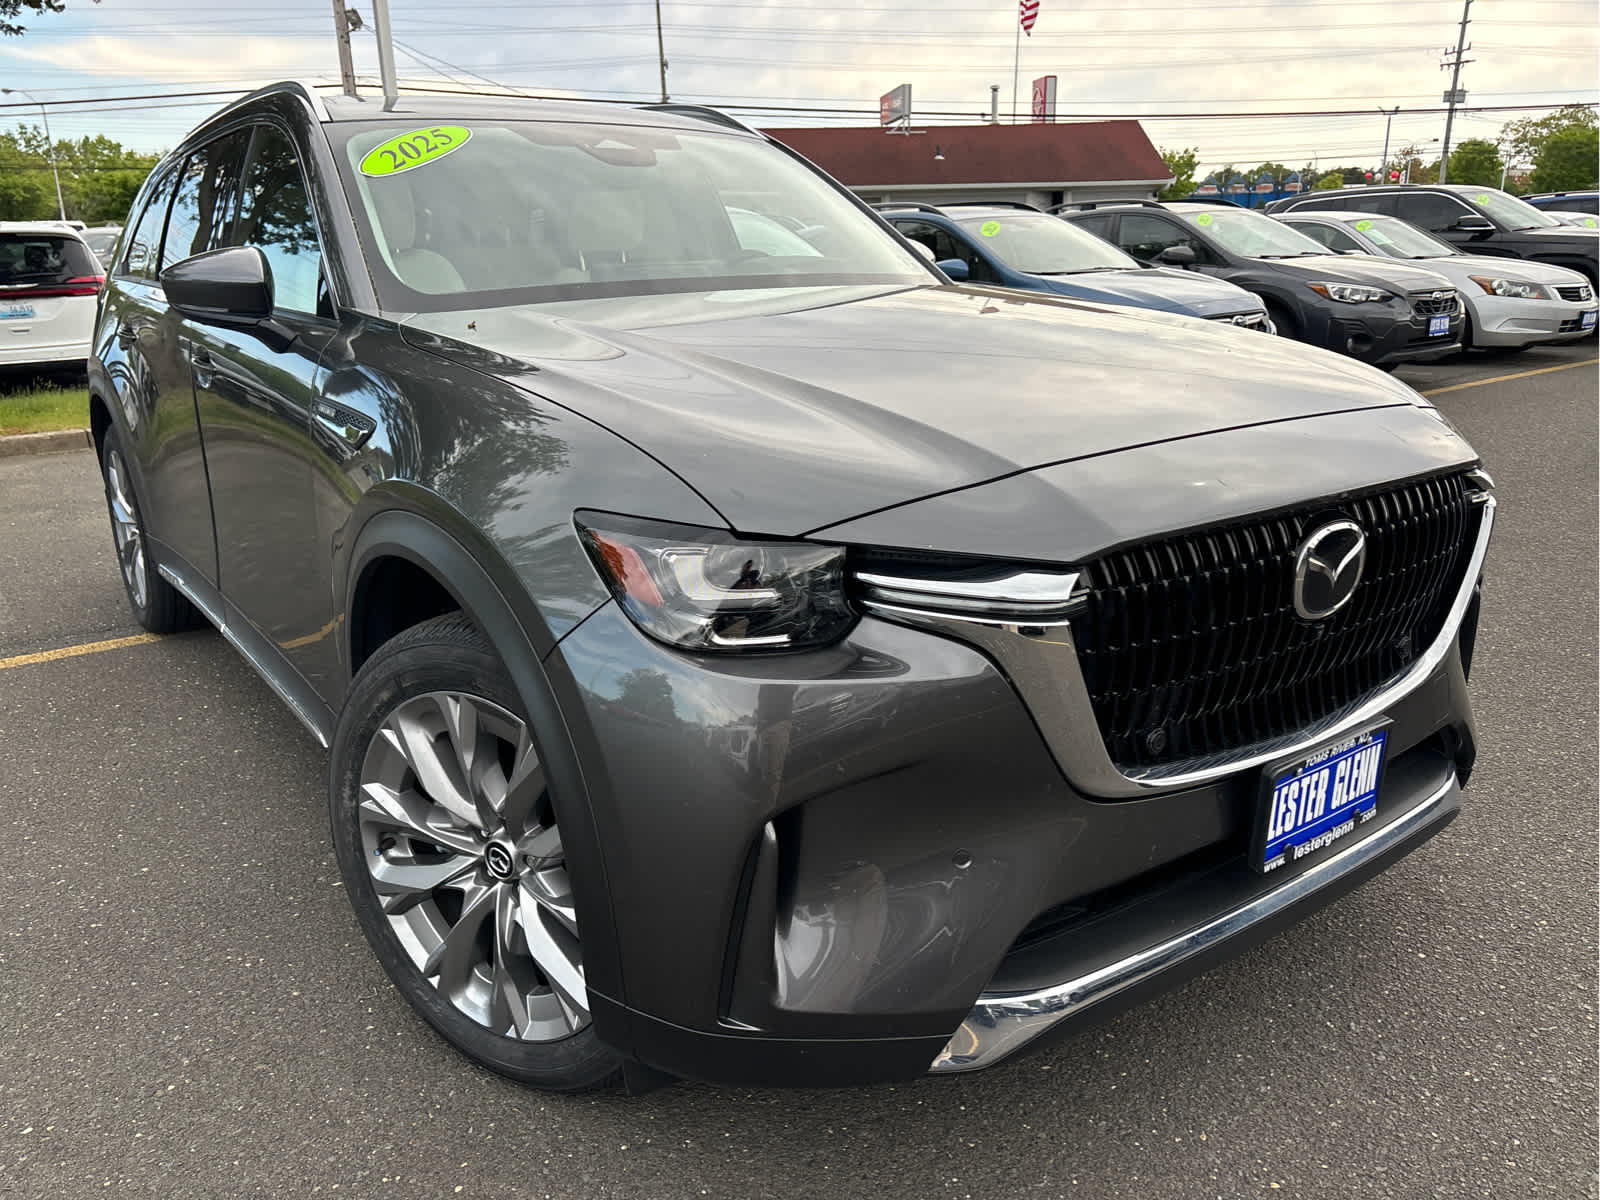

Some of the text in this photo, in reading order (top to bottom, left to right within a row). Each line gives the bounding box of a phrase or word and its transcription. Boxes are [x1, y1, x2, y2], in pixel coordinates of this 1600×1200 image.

[379, 128, 453, 170] 2025
[1305, 749, 1330, 768] TOMS
[1267, 743, 1382, 842] LESTER GLENN
[1293, 820, 1355, 860] lesterglenn
